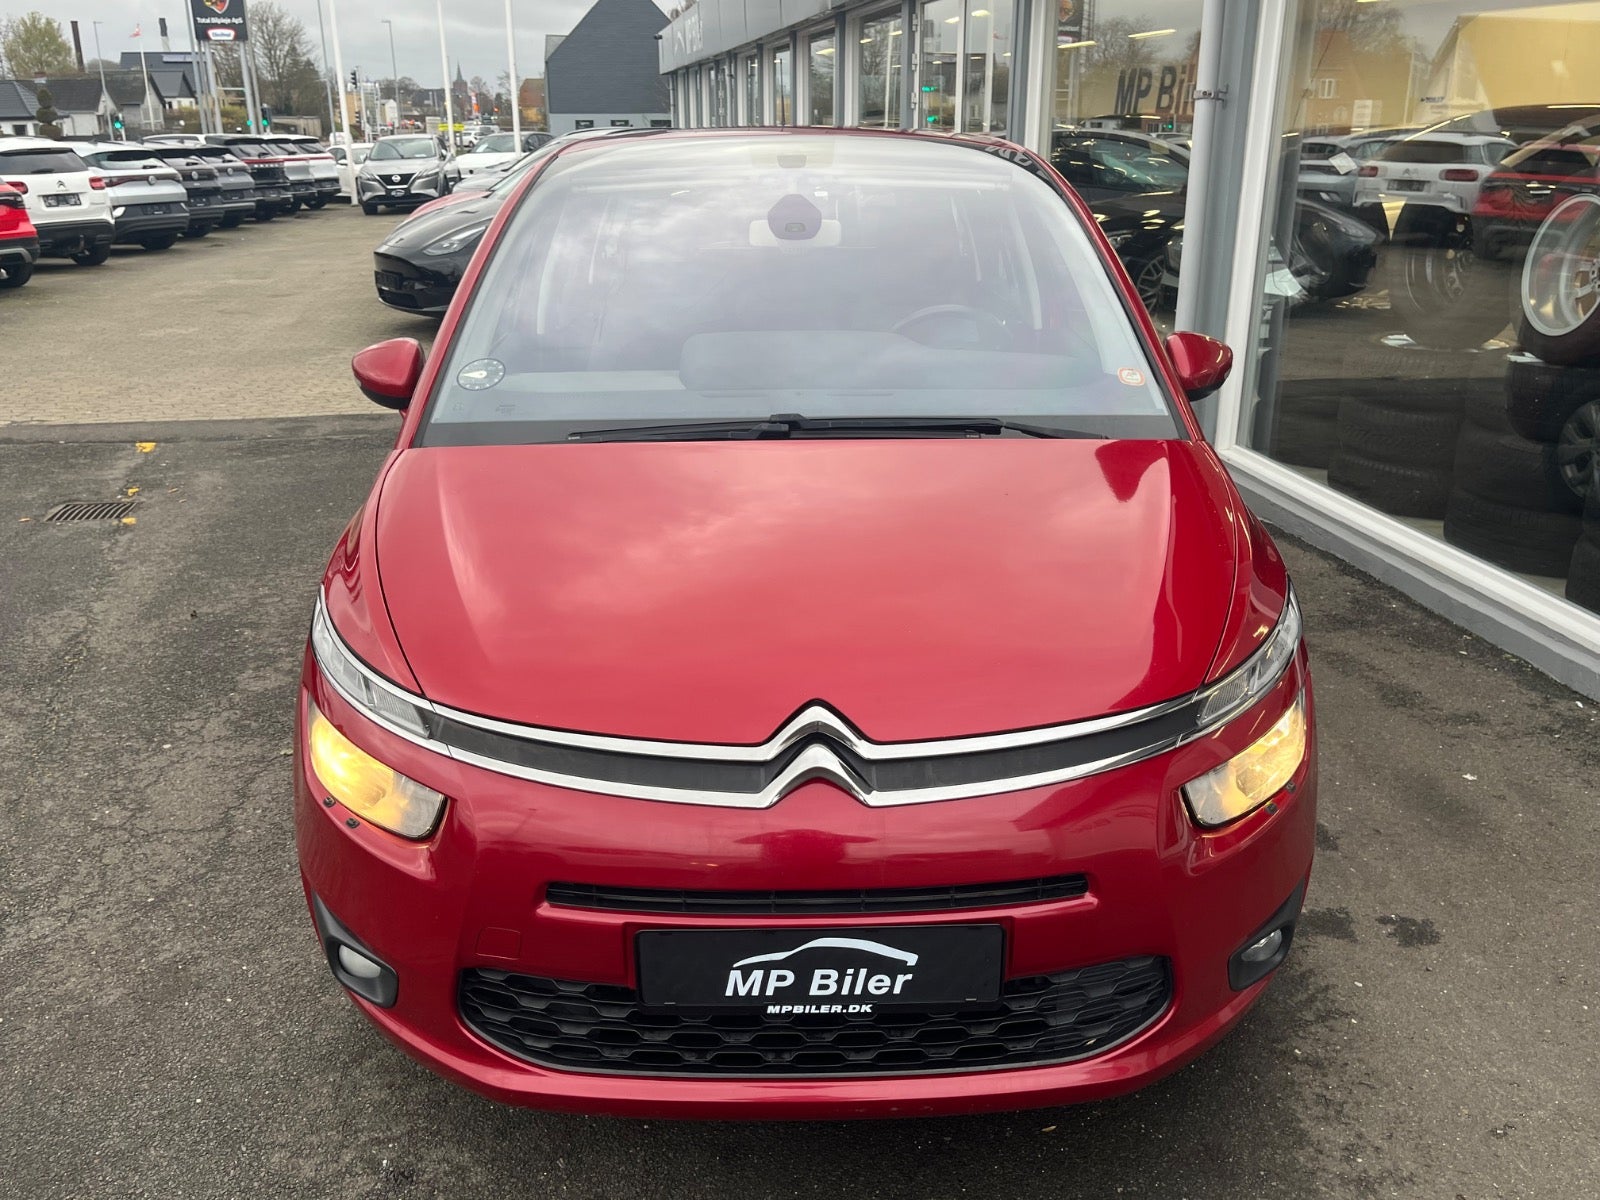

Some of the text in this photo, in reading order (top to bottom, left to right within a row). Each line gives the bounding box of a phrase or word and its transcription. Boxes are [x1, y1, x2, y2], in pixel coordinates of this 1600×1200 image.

[1114, 63, 1196, 114] MP Bil
[724, 968, 913, 997] MP Biler
[766, 1003, 873, 1014] MPBILER.DK
